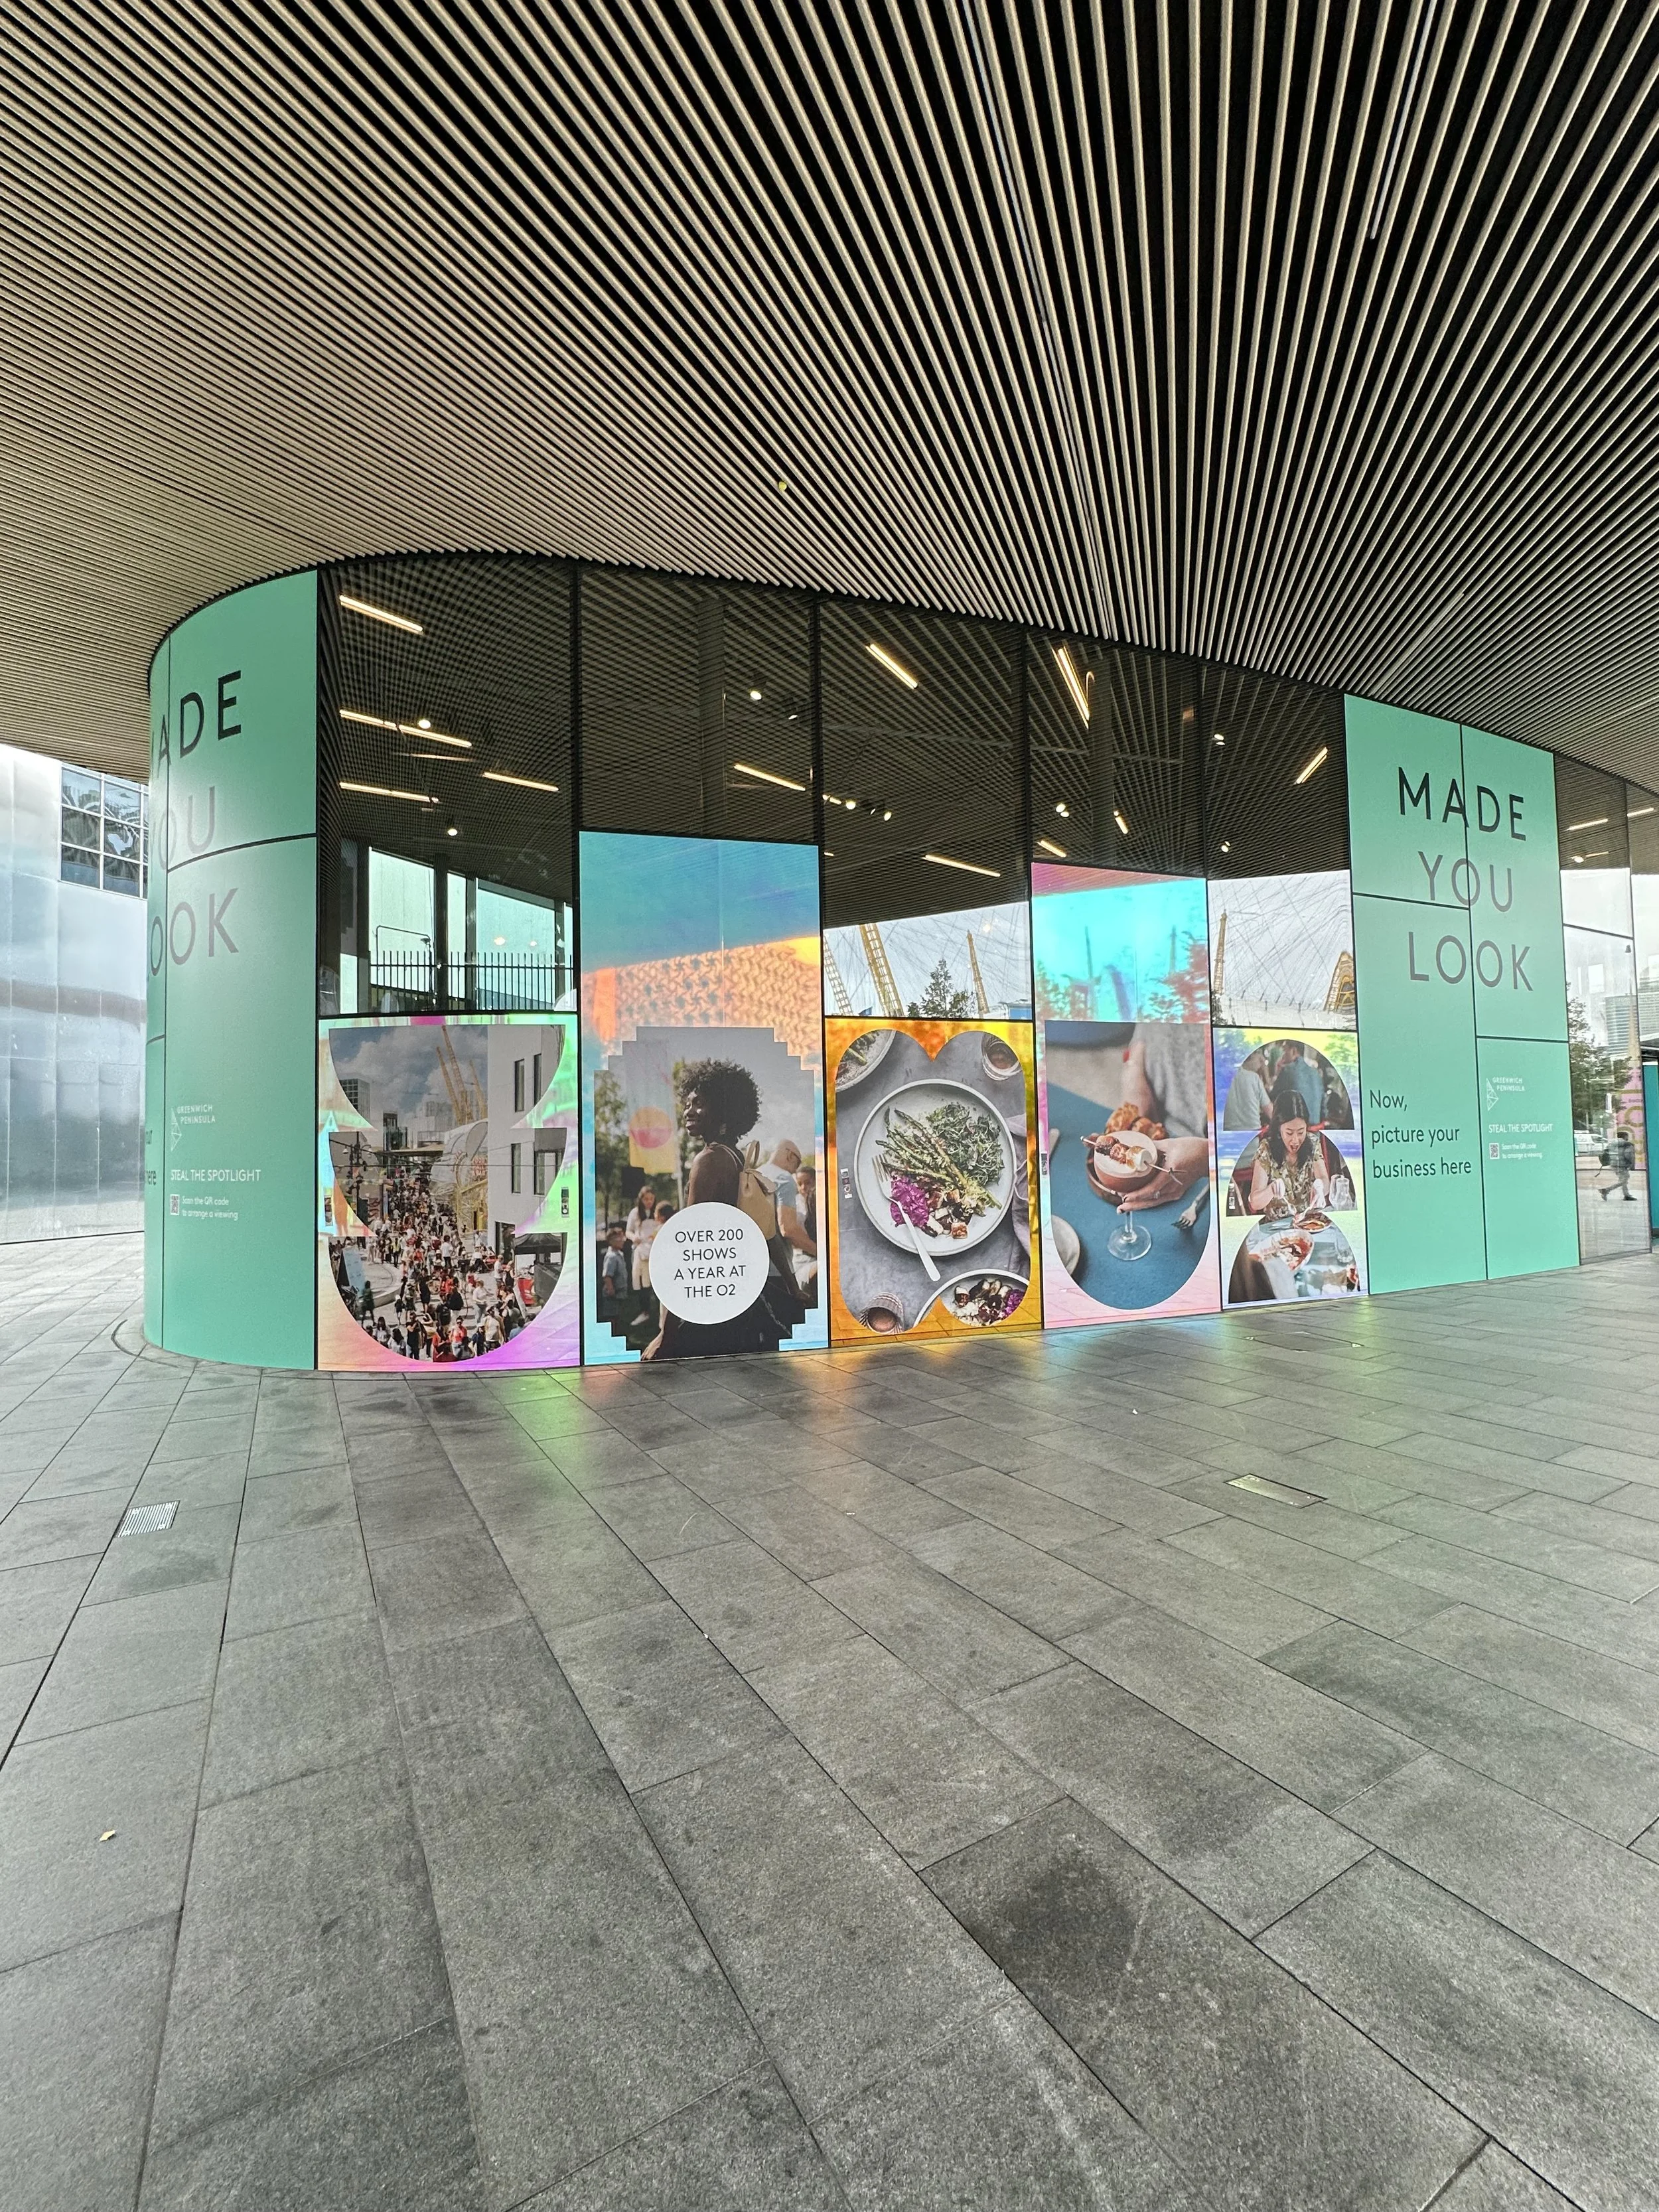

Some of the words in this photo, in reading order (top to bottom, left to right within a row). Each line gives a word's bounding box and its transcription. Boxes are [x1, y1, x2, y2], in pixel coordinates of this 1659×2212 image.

[151, 670, 242, 778] ADE
[1398, 767, 1527, 842] MADE
[151, 786, 215, 870] OU
[1417, 851, 1513, 913] YOU
[1408, 931, 1534, 992] LOOK
[177, 1104, 213, 1114] GREENWICH
[1369, 1090, 1407, 1112] Now,
[180, 1115, 216, 1124] PENINSULA
[1488, 1124, 1507, 1133] STEAL
[1508, 1124, 1520, 1132] THE
[1520, 1123, 1553, 1132] SPOTLIGHT
[1371, 1124, 1425, 1149] picture
[1429, 1128, 1460, 1147] your
[171, 1169, 188, 1181] STEAL
[190, 1169, 205, 1181] THE
[207, 1169, 261, 1181] SPOTLIGHT
[1373, 1159, 1436, 1179] business
[1441, 1157, 1472, 1175] here
[194, 1196, 204, 1205] the
[214, 1197, 229, 1205] code
[675, 1230, 714, 1243] OVER
[718, 1228, 743, 1241] 200
[683, 1247, 737, 1261] SHOWS
[674, 1268, 684, 1281] A
[687, 1266, 725, 1280] YEAR
[729, 1265, 747, 1278] AT
[684, 1286, 713, 1298] THE
[717, 1284, 736, 1296] O2
